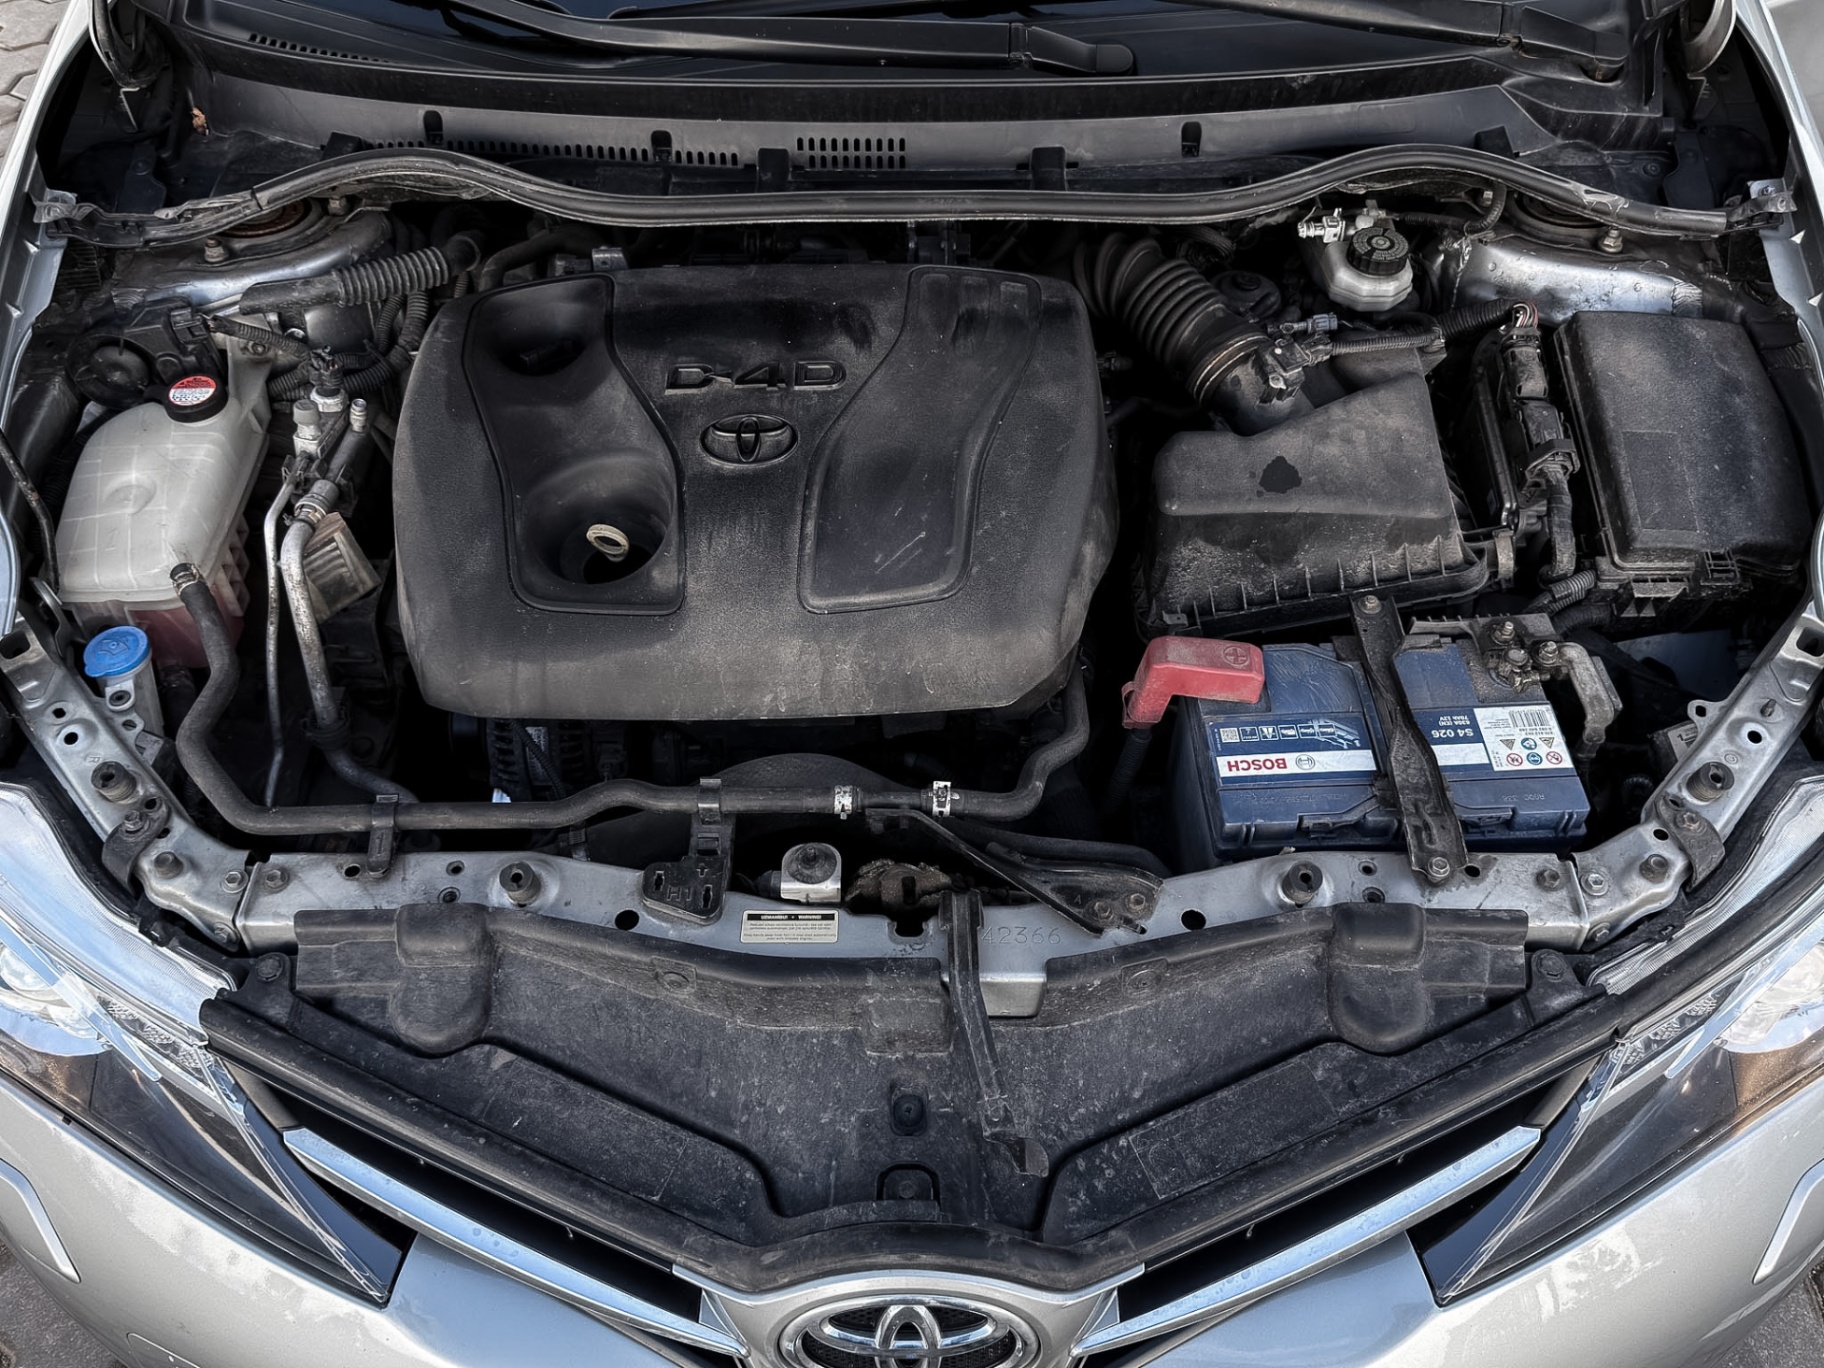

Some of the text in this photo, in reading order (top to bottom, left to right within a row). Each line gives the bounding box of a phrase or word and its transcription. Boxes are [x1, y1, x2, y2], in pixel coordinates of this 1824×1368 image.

[665, 361, 847, 396] D-4D
[1431, 728, 1474, 738] S4 026
[1226, 757, 1288, 772] BOSCH
[981, 926, 1061, 944] 42366
